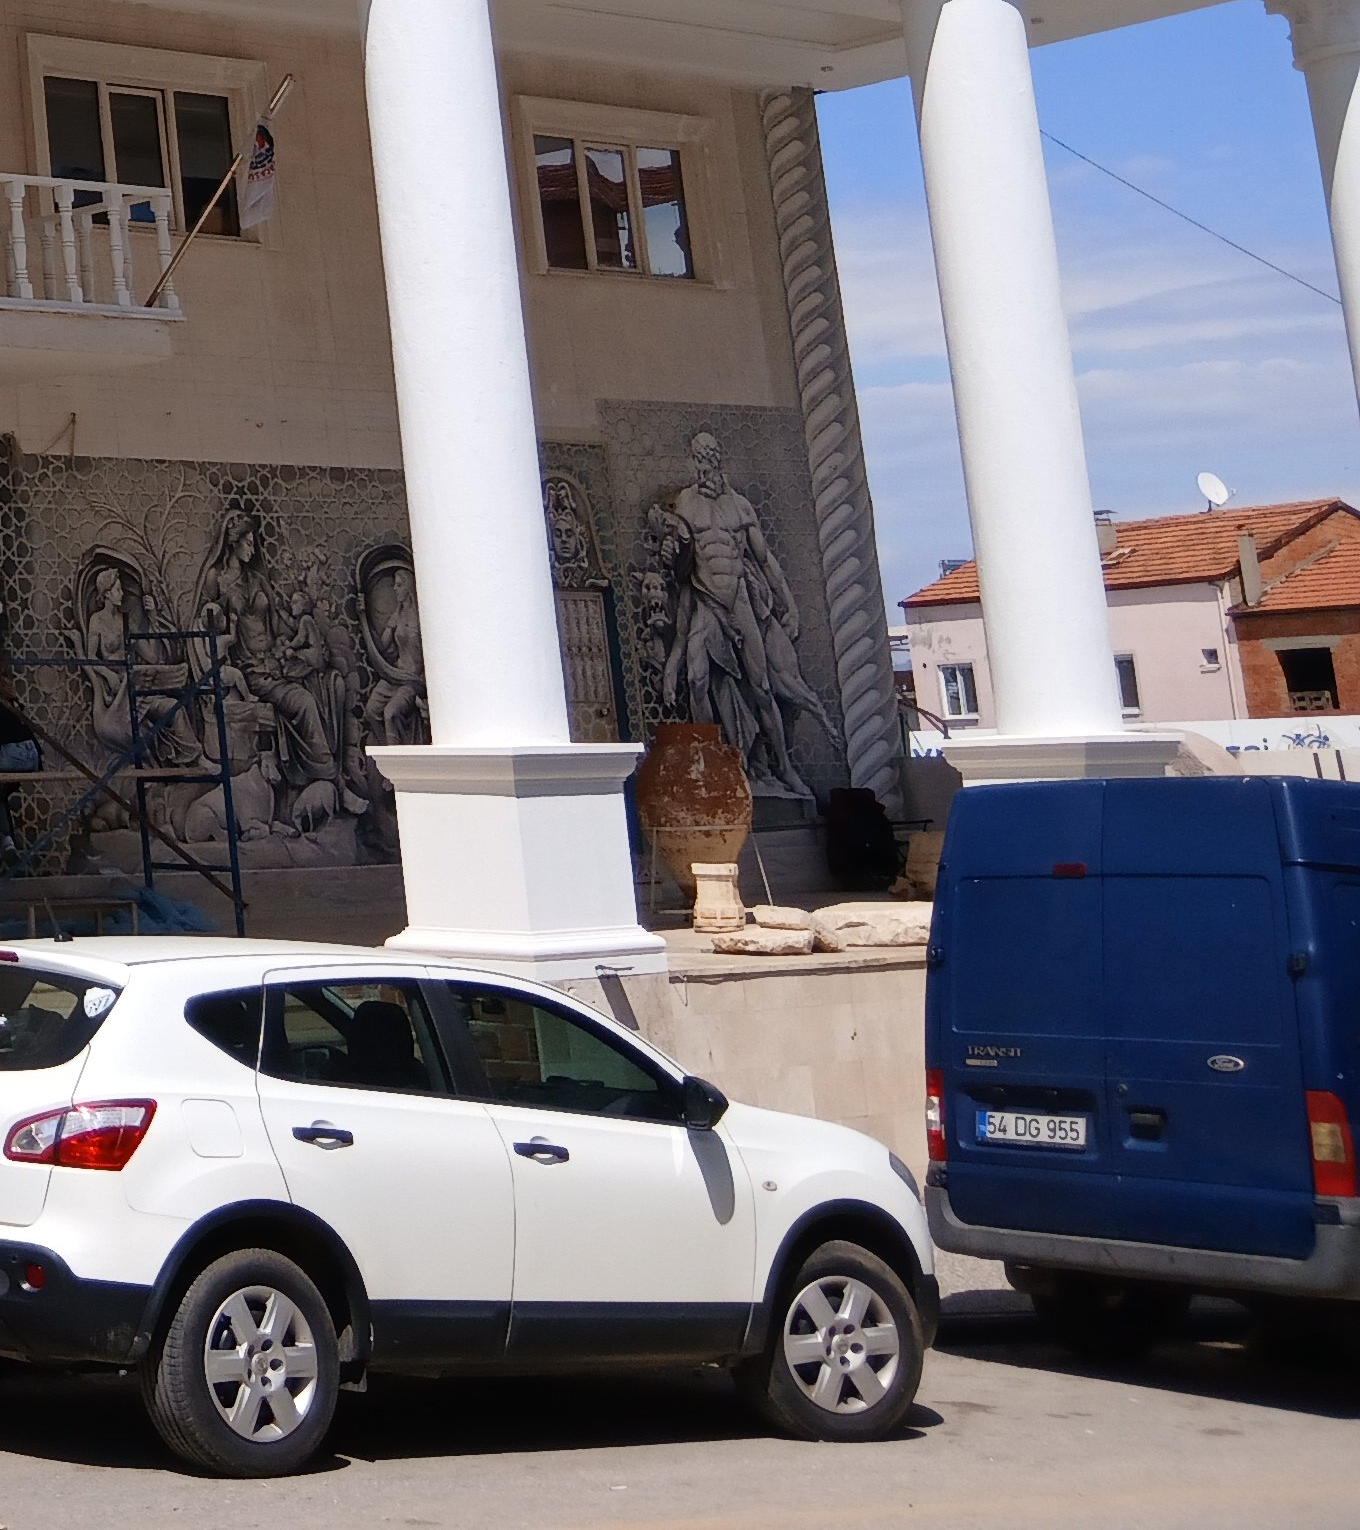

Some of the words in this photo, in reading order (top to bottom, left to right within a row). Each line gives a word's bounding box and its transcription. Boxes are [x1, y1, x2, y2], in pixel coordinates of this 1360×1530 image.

[967, 1045, 1022, 1058] TRANSIT
[986, 1114, 1008, 1136] 54
[1014, 1116, 1041, 1139] DG
[1046, 1119, 1080, 1142] 955
